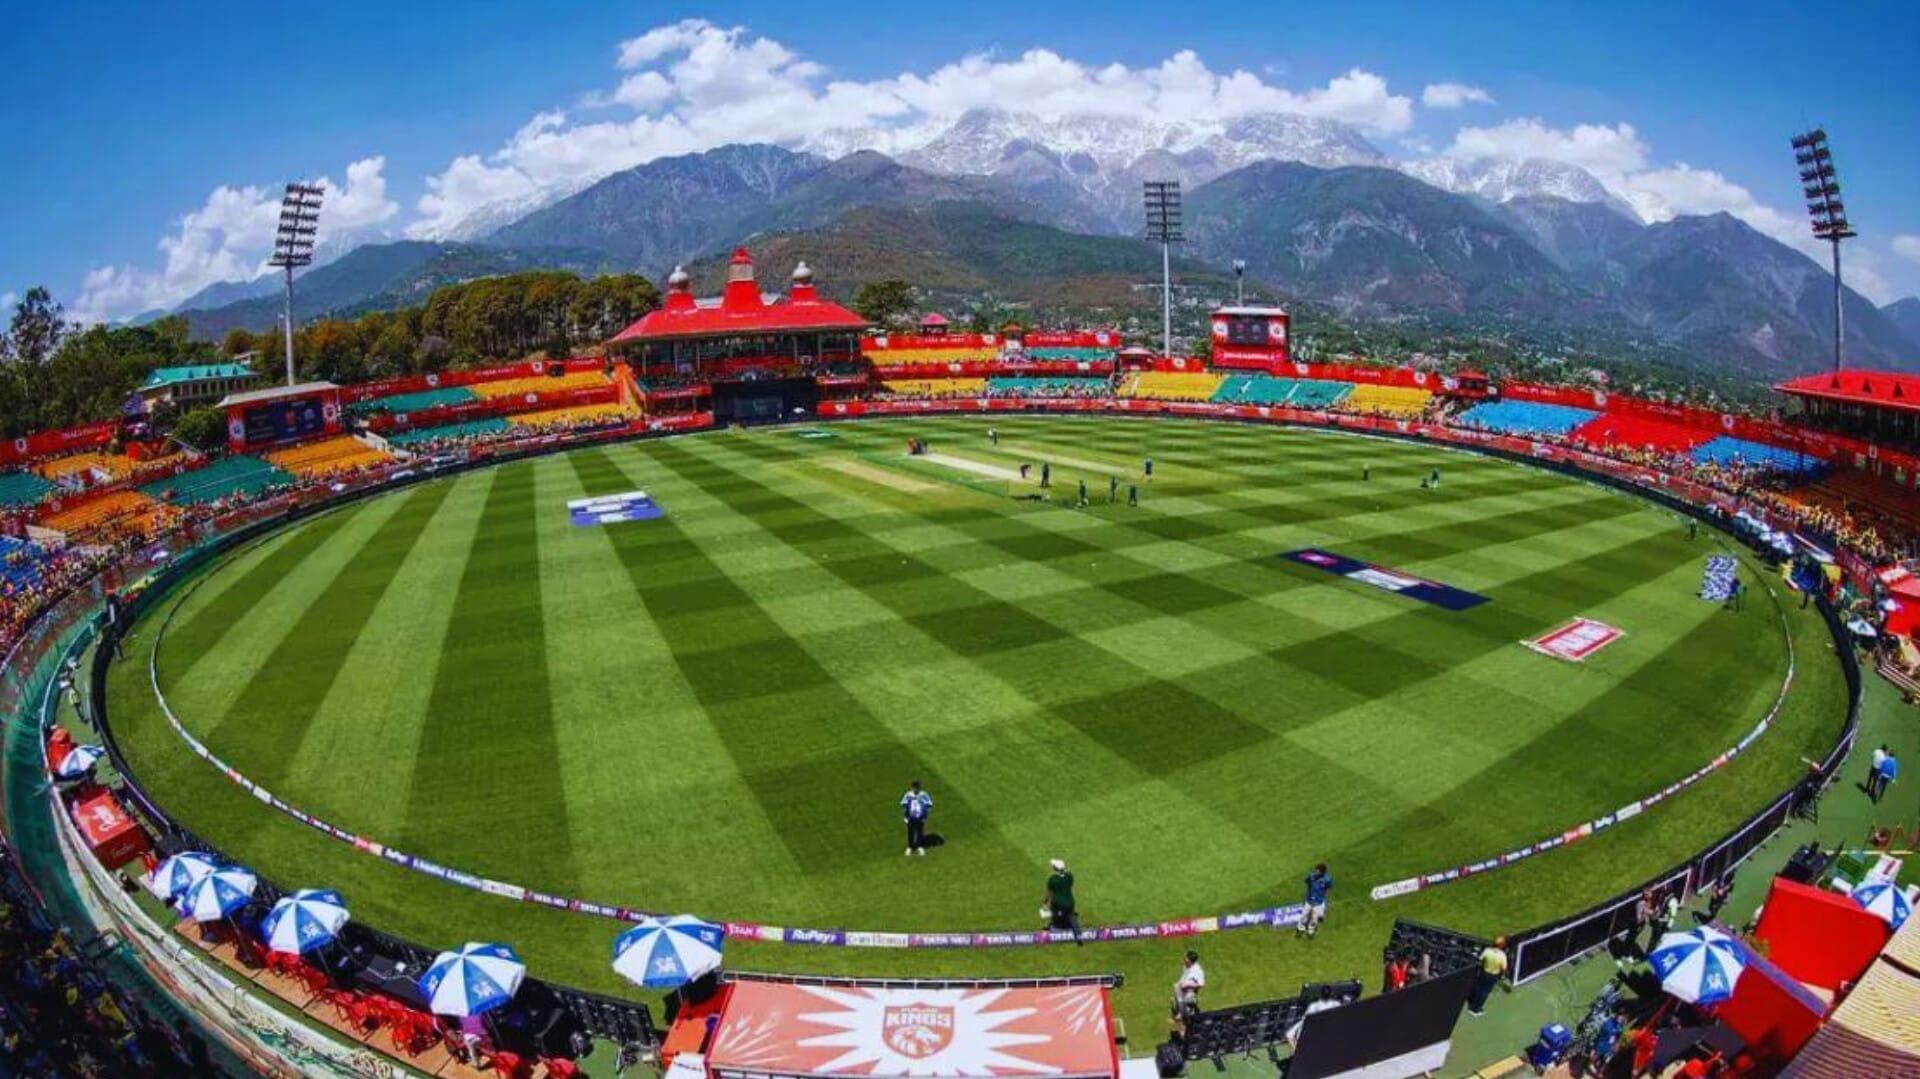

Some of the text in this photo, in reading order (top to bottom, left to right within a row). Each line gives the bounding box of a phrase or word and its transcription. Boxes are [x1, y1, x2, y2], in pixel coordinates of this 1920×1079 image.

[1049, 932, 1075, 941] TATA
[1112, 928, 1137, 938] TATA
[923, 936, 948, 945] TATA
[986, 935, 1012, 944] TATA
[886, 1012, 951, 1028] KINGS
